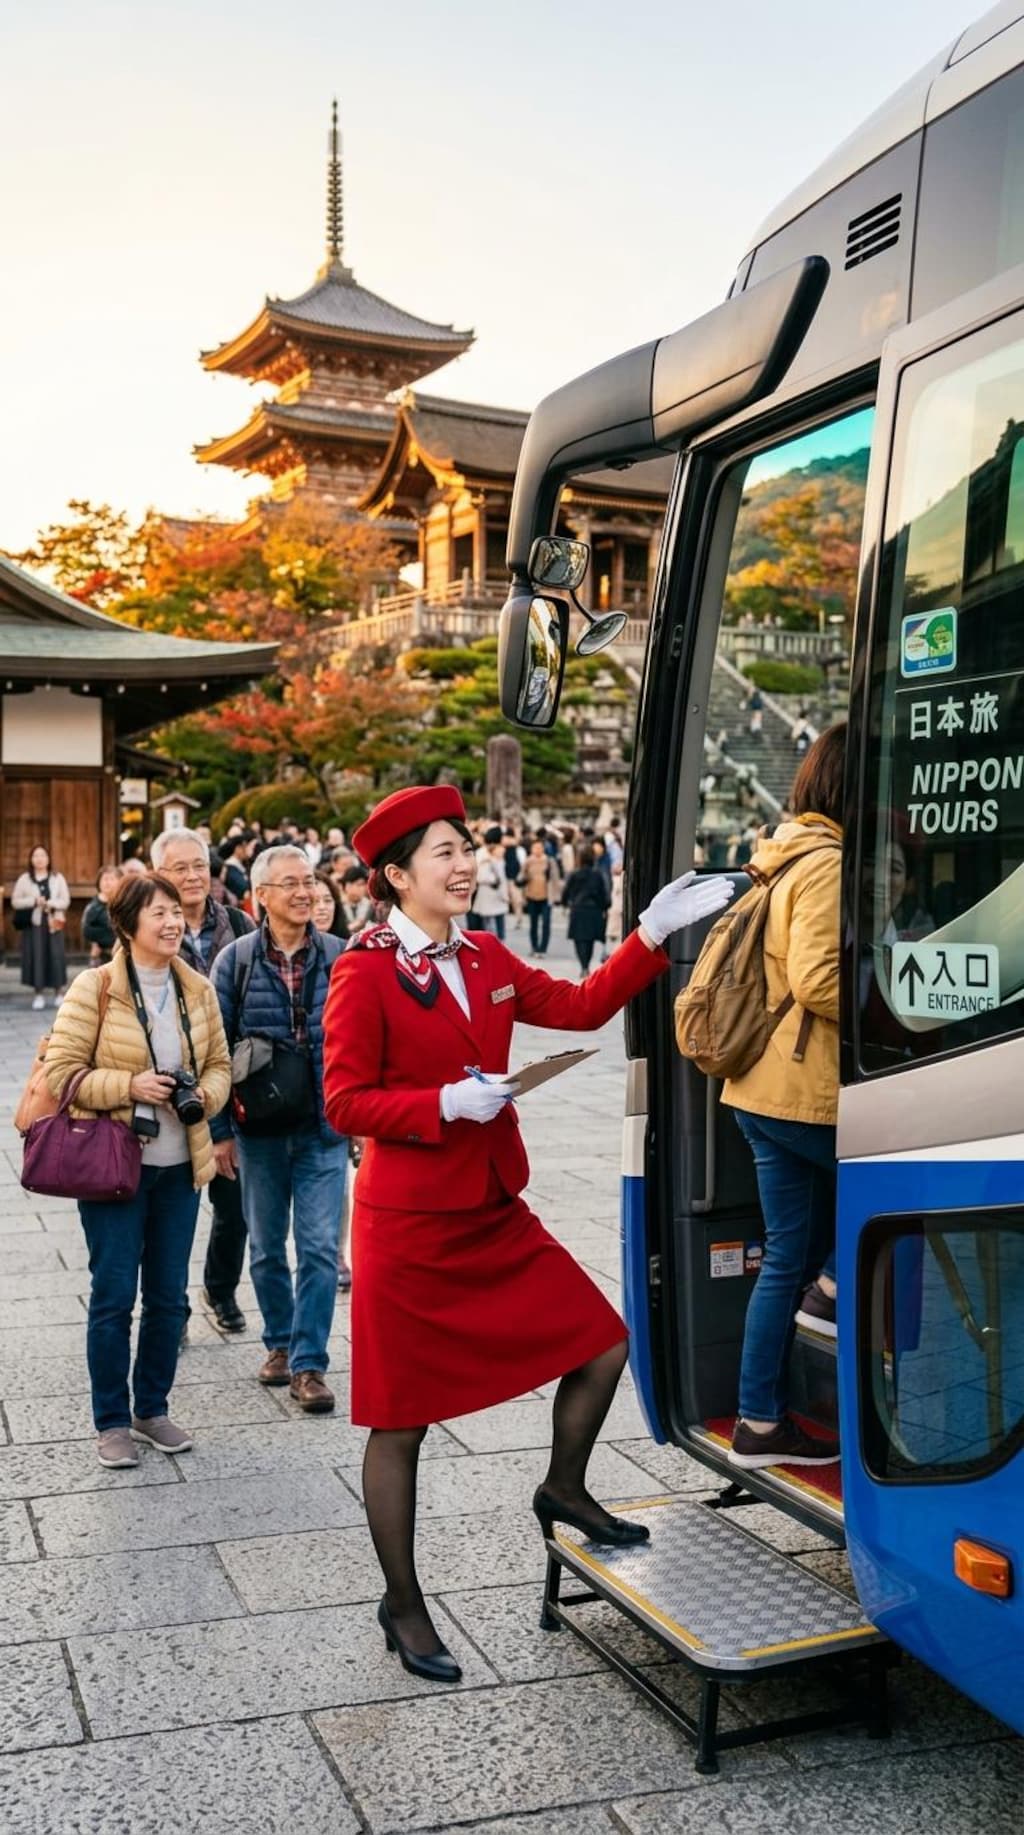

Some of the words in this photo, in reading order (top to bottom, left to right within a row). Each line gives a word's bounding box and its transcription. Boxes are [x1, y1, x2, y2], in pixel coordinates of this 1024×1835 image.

[910, 691, 999, 740] 日本旅
[911, 755, 1024, 796] NIPPON
[907, 799, 999, 834] TOURS
[931, 950, 989, 988] 入口
[927, 993, 994, 1013] ENTRANCE
